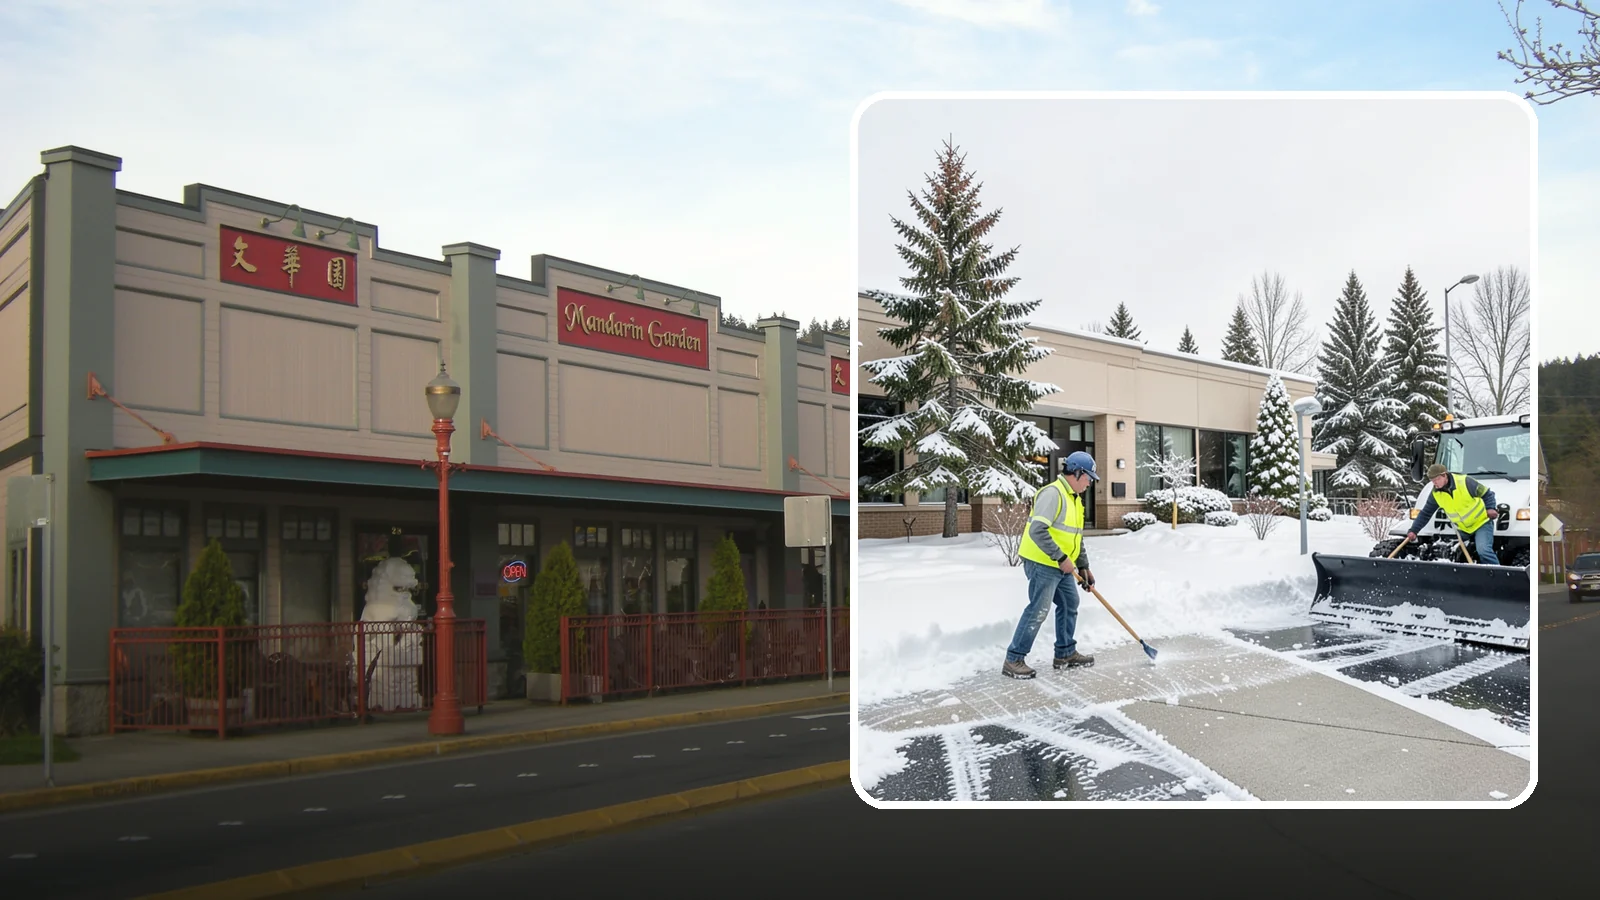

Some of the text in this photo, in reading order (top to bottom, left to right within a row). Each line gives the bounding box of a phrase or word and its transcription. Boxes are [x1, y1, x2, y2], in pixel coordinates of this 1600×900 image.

[231, 235, 346, 291] 文華園
[564, 302, 702, 352] Mandarin Garden
[503, 565, 527, 578] OPEN
